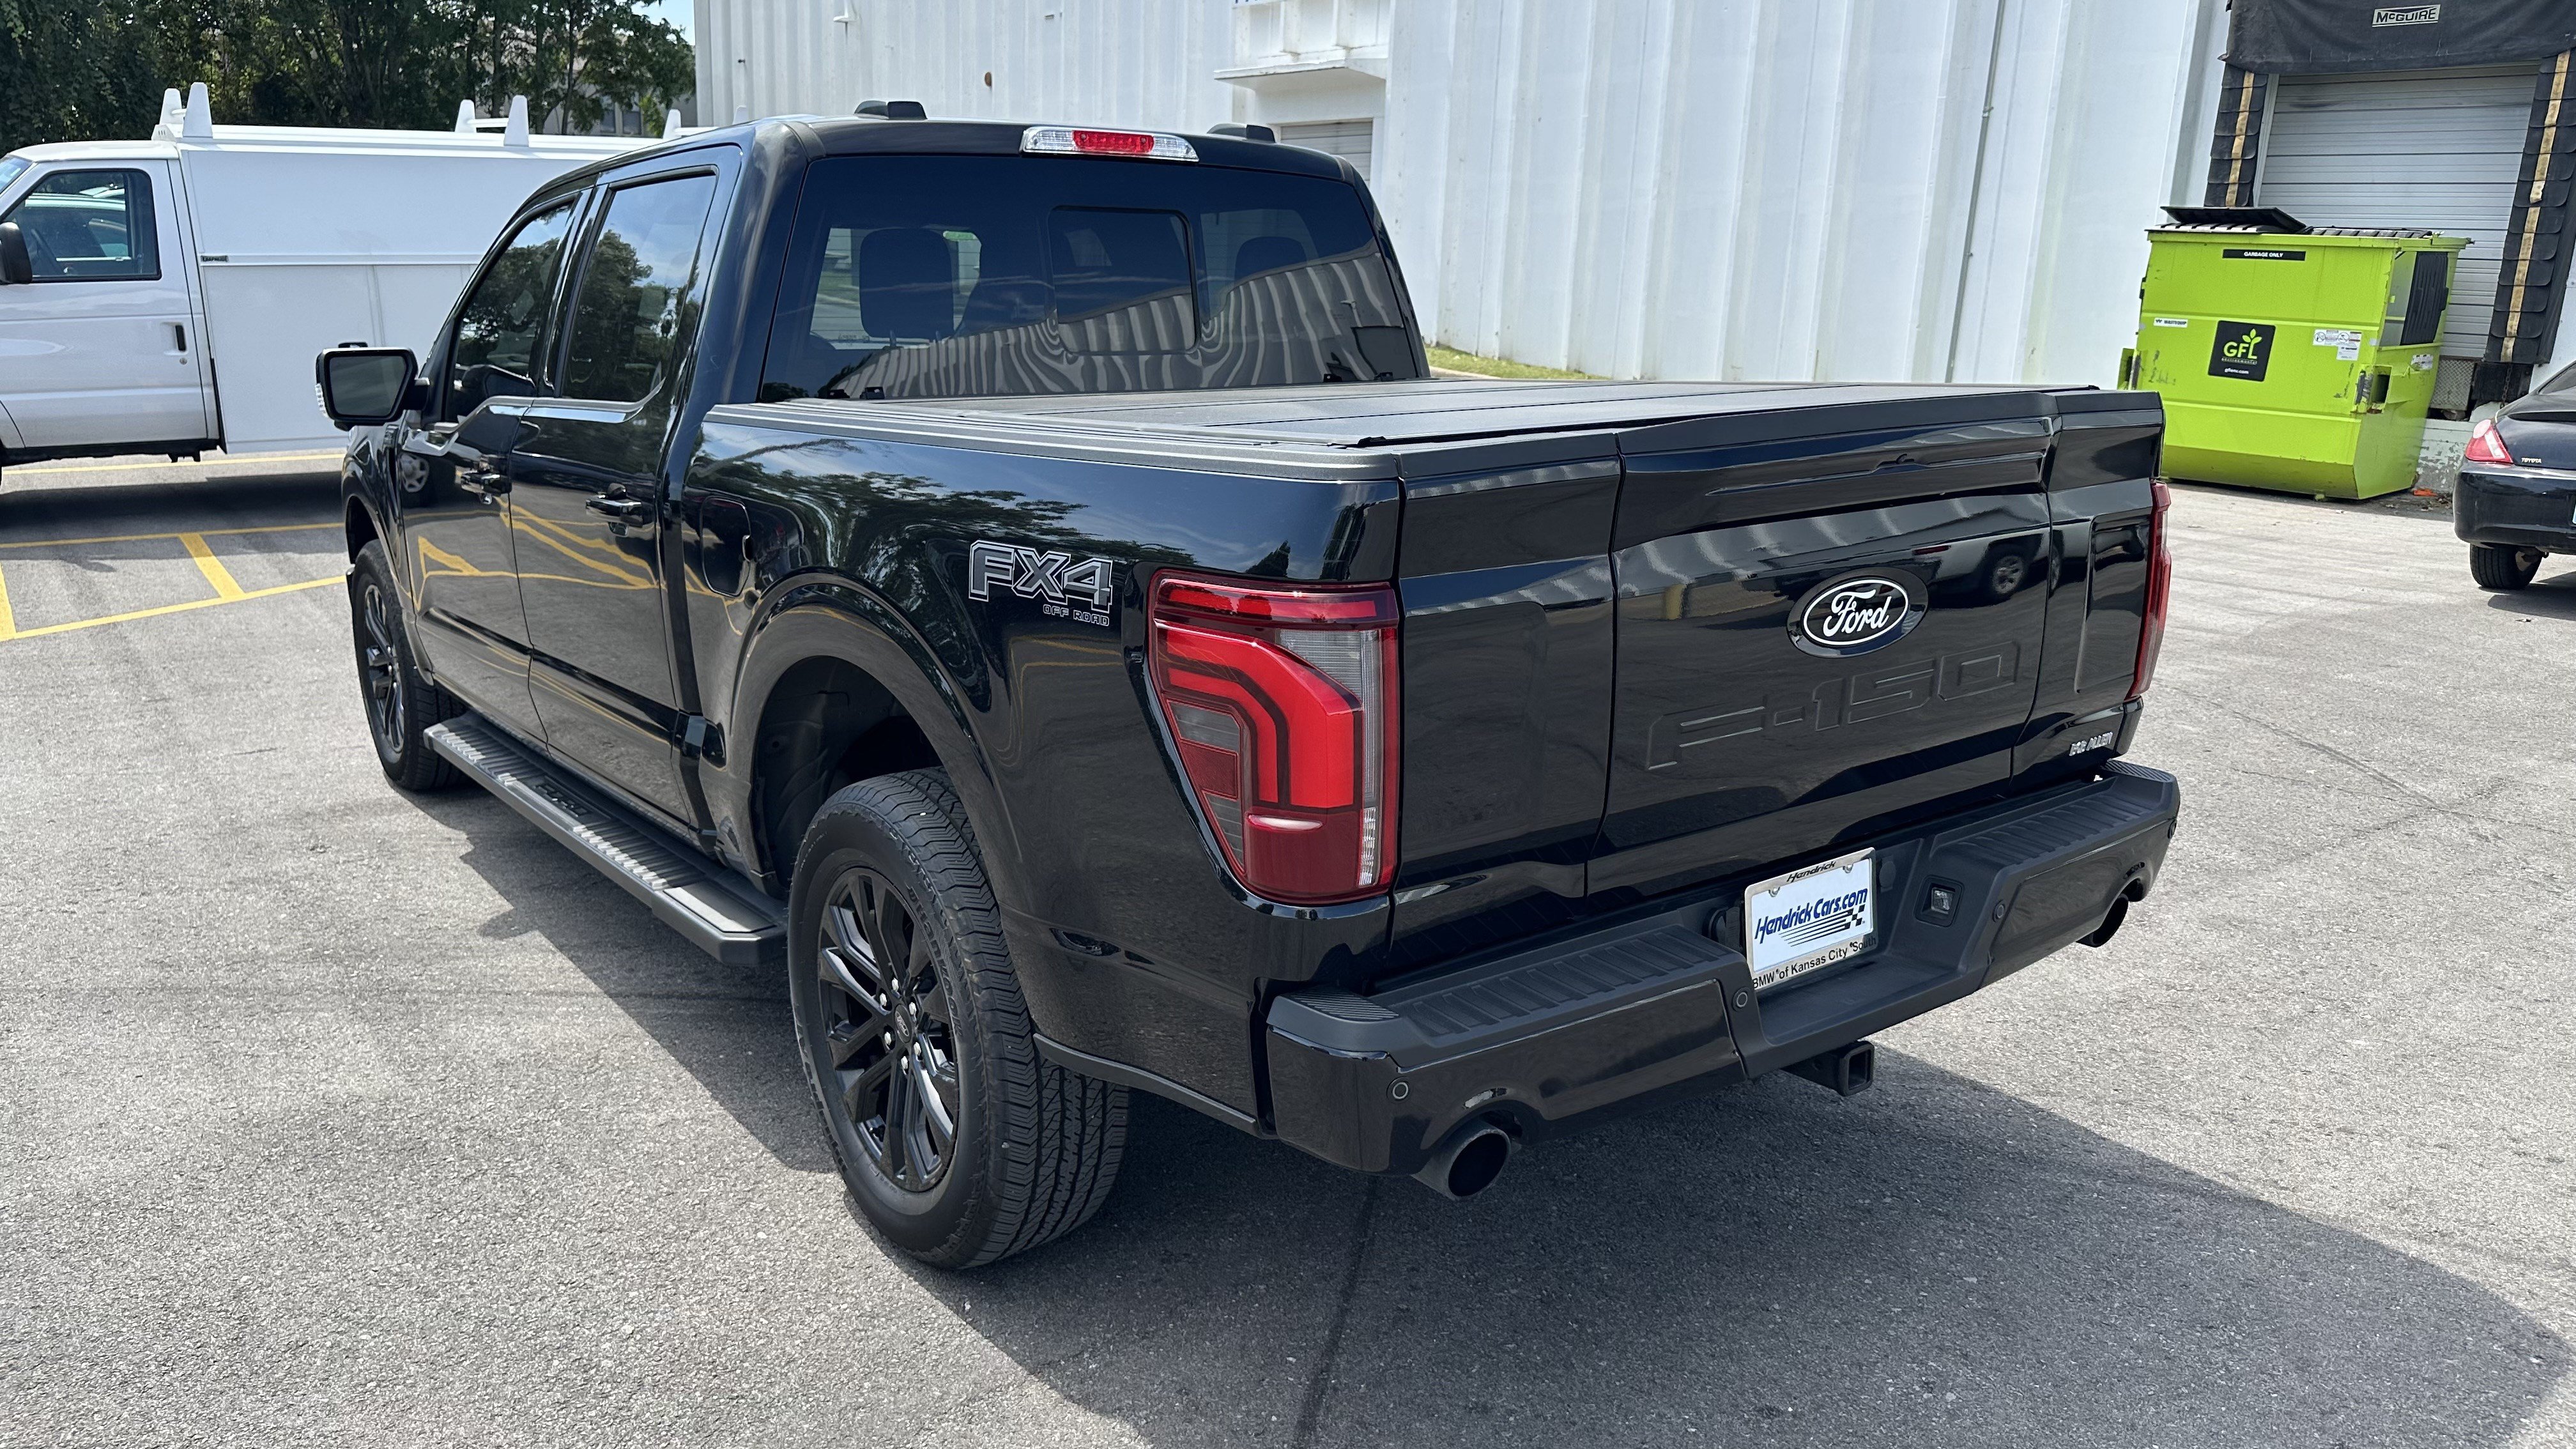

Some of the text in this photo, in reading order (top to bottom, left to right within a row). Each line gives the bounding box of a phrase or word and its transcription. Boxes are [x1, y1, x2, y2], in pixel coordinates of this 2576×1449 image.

[2223, 337, 2262, 360] GFL
[968, 539, 1114, 614] FX4
[1042, 603, 1110, 627] OFF ROAD
[1822, 588, 1893, 638] Ford
[1648, 641, 2021, 770] F-150
[1786, 861, 1837, 884] Hendrick
[1752, 937, 1877, 989] BMW of Kansas City South
